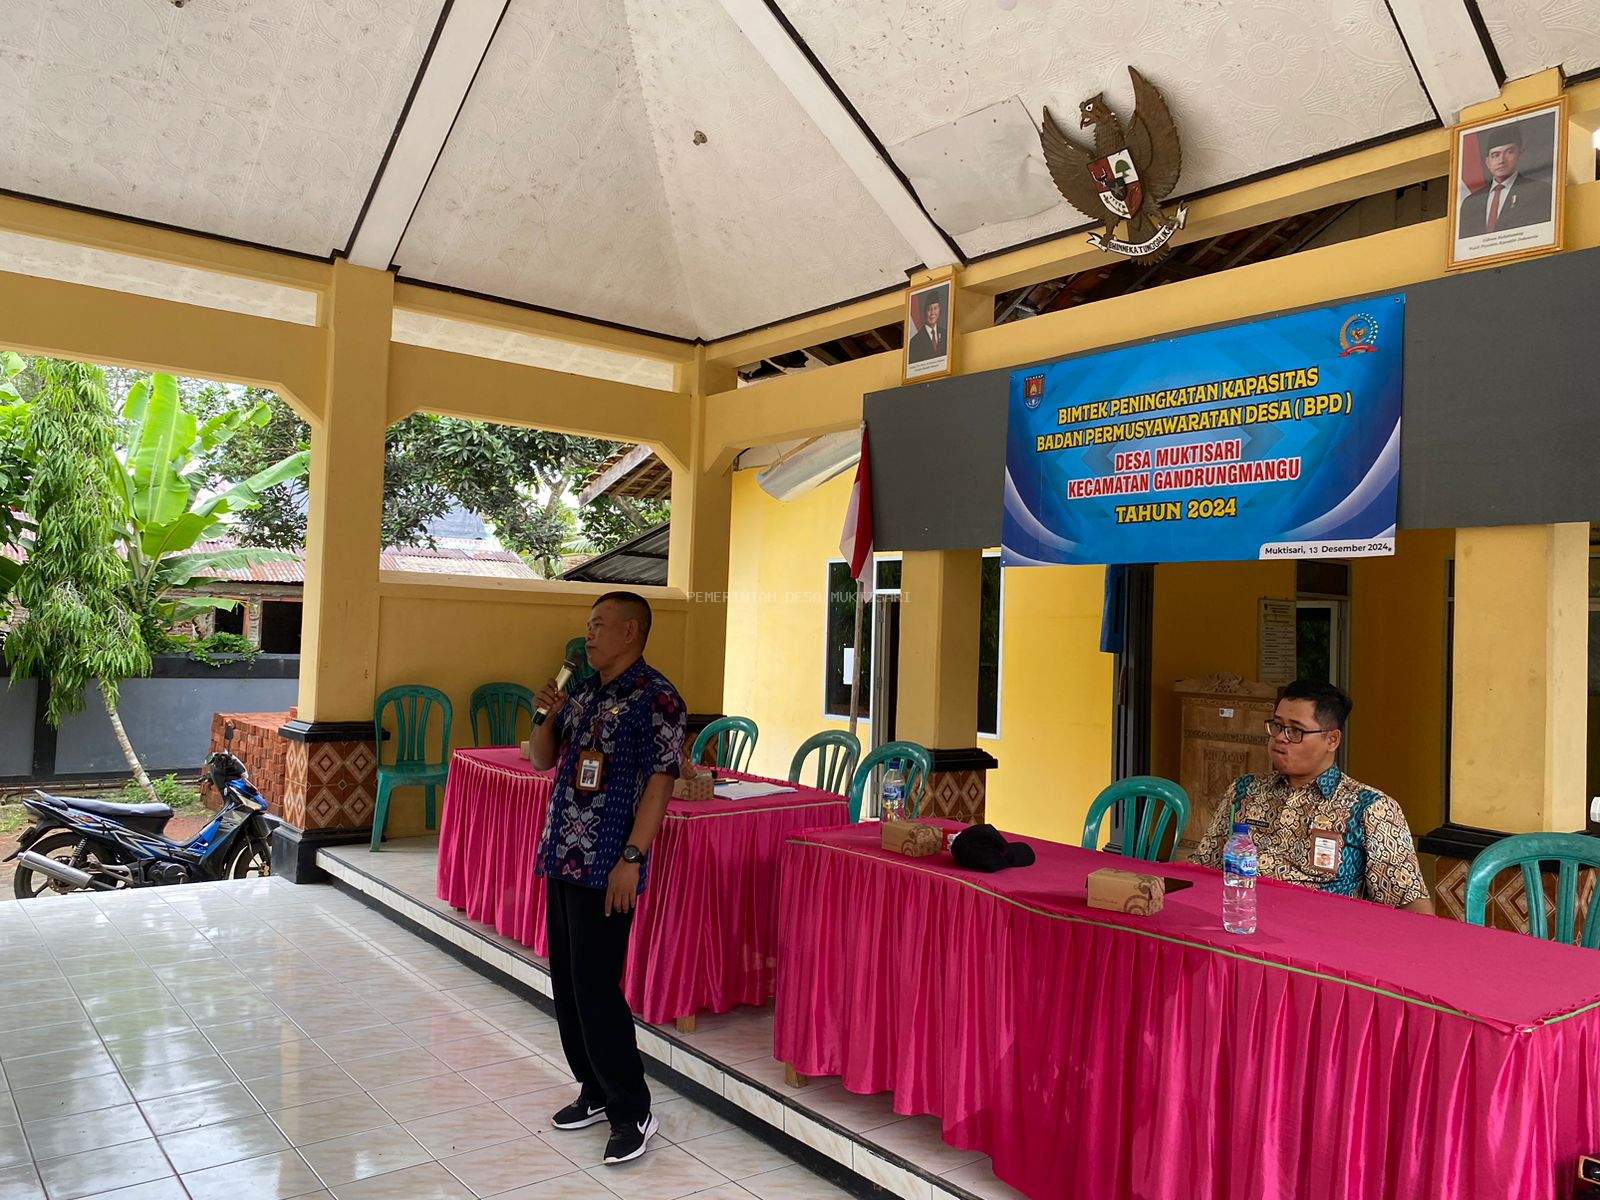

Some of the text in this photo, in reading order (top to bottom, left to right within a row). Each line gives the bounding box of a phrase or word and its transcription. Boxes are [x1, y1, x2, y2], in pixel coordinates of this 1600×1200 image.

[1058, 366, 1319, 424] BIMTEK PENINGKATAN KAPASITAS
[1036, 431, 1083, 451] BADAN
[1085, 407, 1242, 445] PERMUSYAWARATAN
[1245, 399, 1291, 424] DESA
[1115, 440, 1241, 472] DESA MUKTISARI
[1068, 458, 1300, 498] KECAMATAN GANDRUNGMANGU
[1115, 498, 1237, 523] TAHUN 2024
[1265, 546, 1306, 555] Muktisari,
[1321, 545, 1366, 553] Desember
